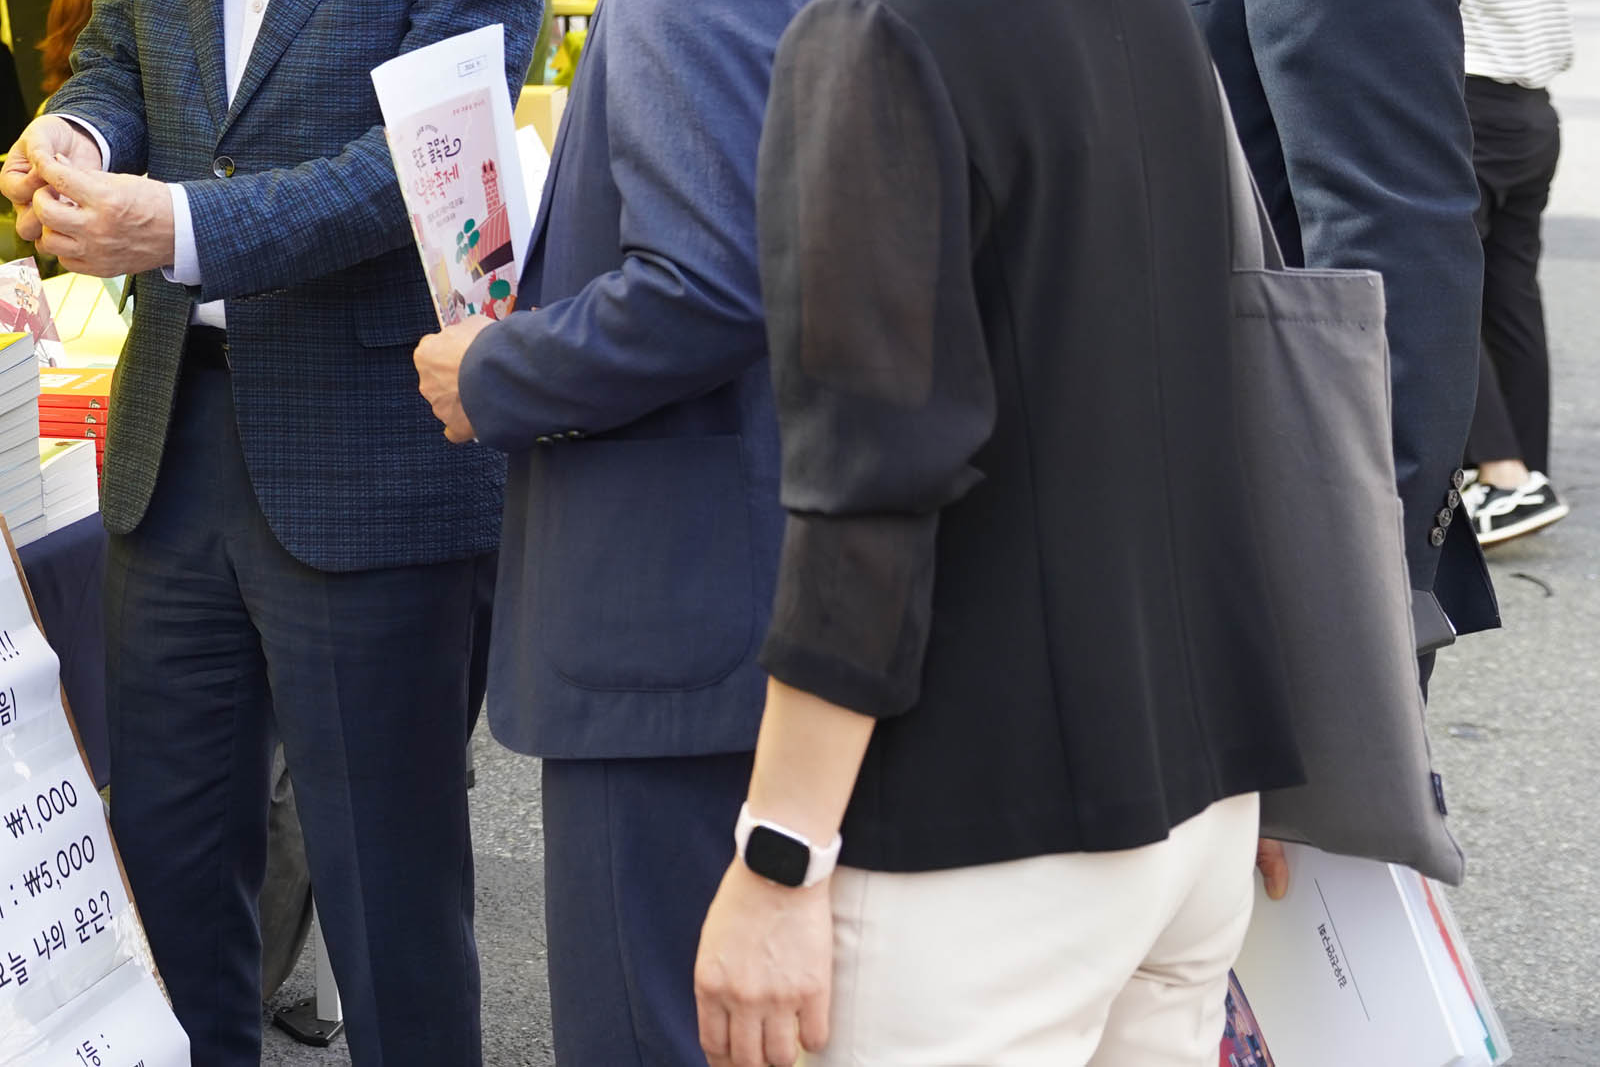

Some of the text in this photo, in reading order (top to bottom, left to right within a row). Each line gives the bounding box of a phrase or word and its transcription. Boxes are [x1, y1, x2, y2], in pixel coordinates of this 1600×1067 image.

[3, 780, 78, 839] ₩1,000
[23, 834, 95, 898] ₩5,000
[33, 920, 67, 960] 나의
[74, 890, 113, 944] 운은?
[1317, 923, 1348, 989] 김우진연구회
